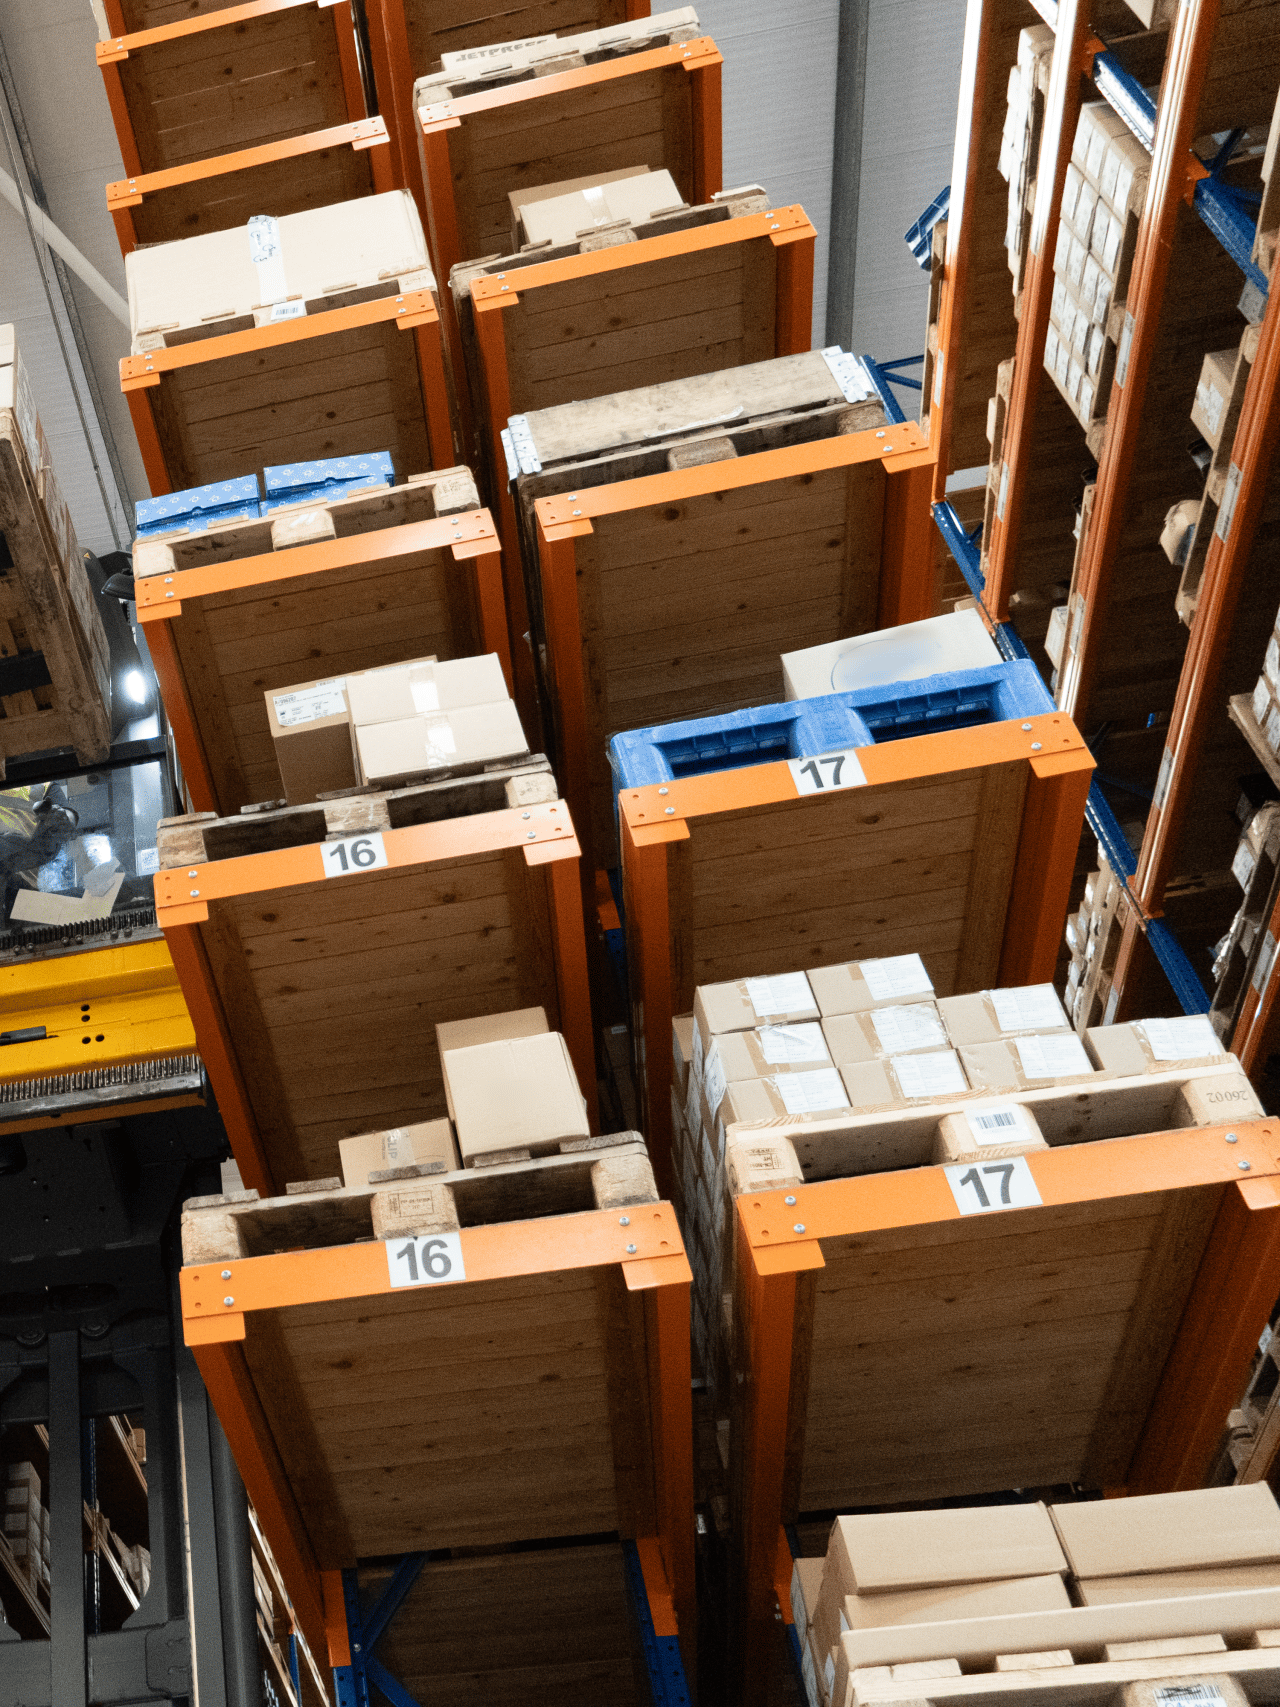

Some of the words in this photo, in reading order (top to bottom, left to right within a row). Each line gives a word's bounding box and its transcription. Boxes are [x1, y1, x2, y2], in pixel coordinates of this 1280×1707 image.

[456, 39, 548, 62] JETPRE
[800, 756, 845, 788] 17
[330, 839, 376, 871] 16
[1206, 1090, 1248, 1103] 26002
[960, 1163, 1014, 1207] 17
[397, 1239, 451, 1280] 16
